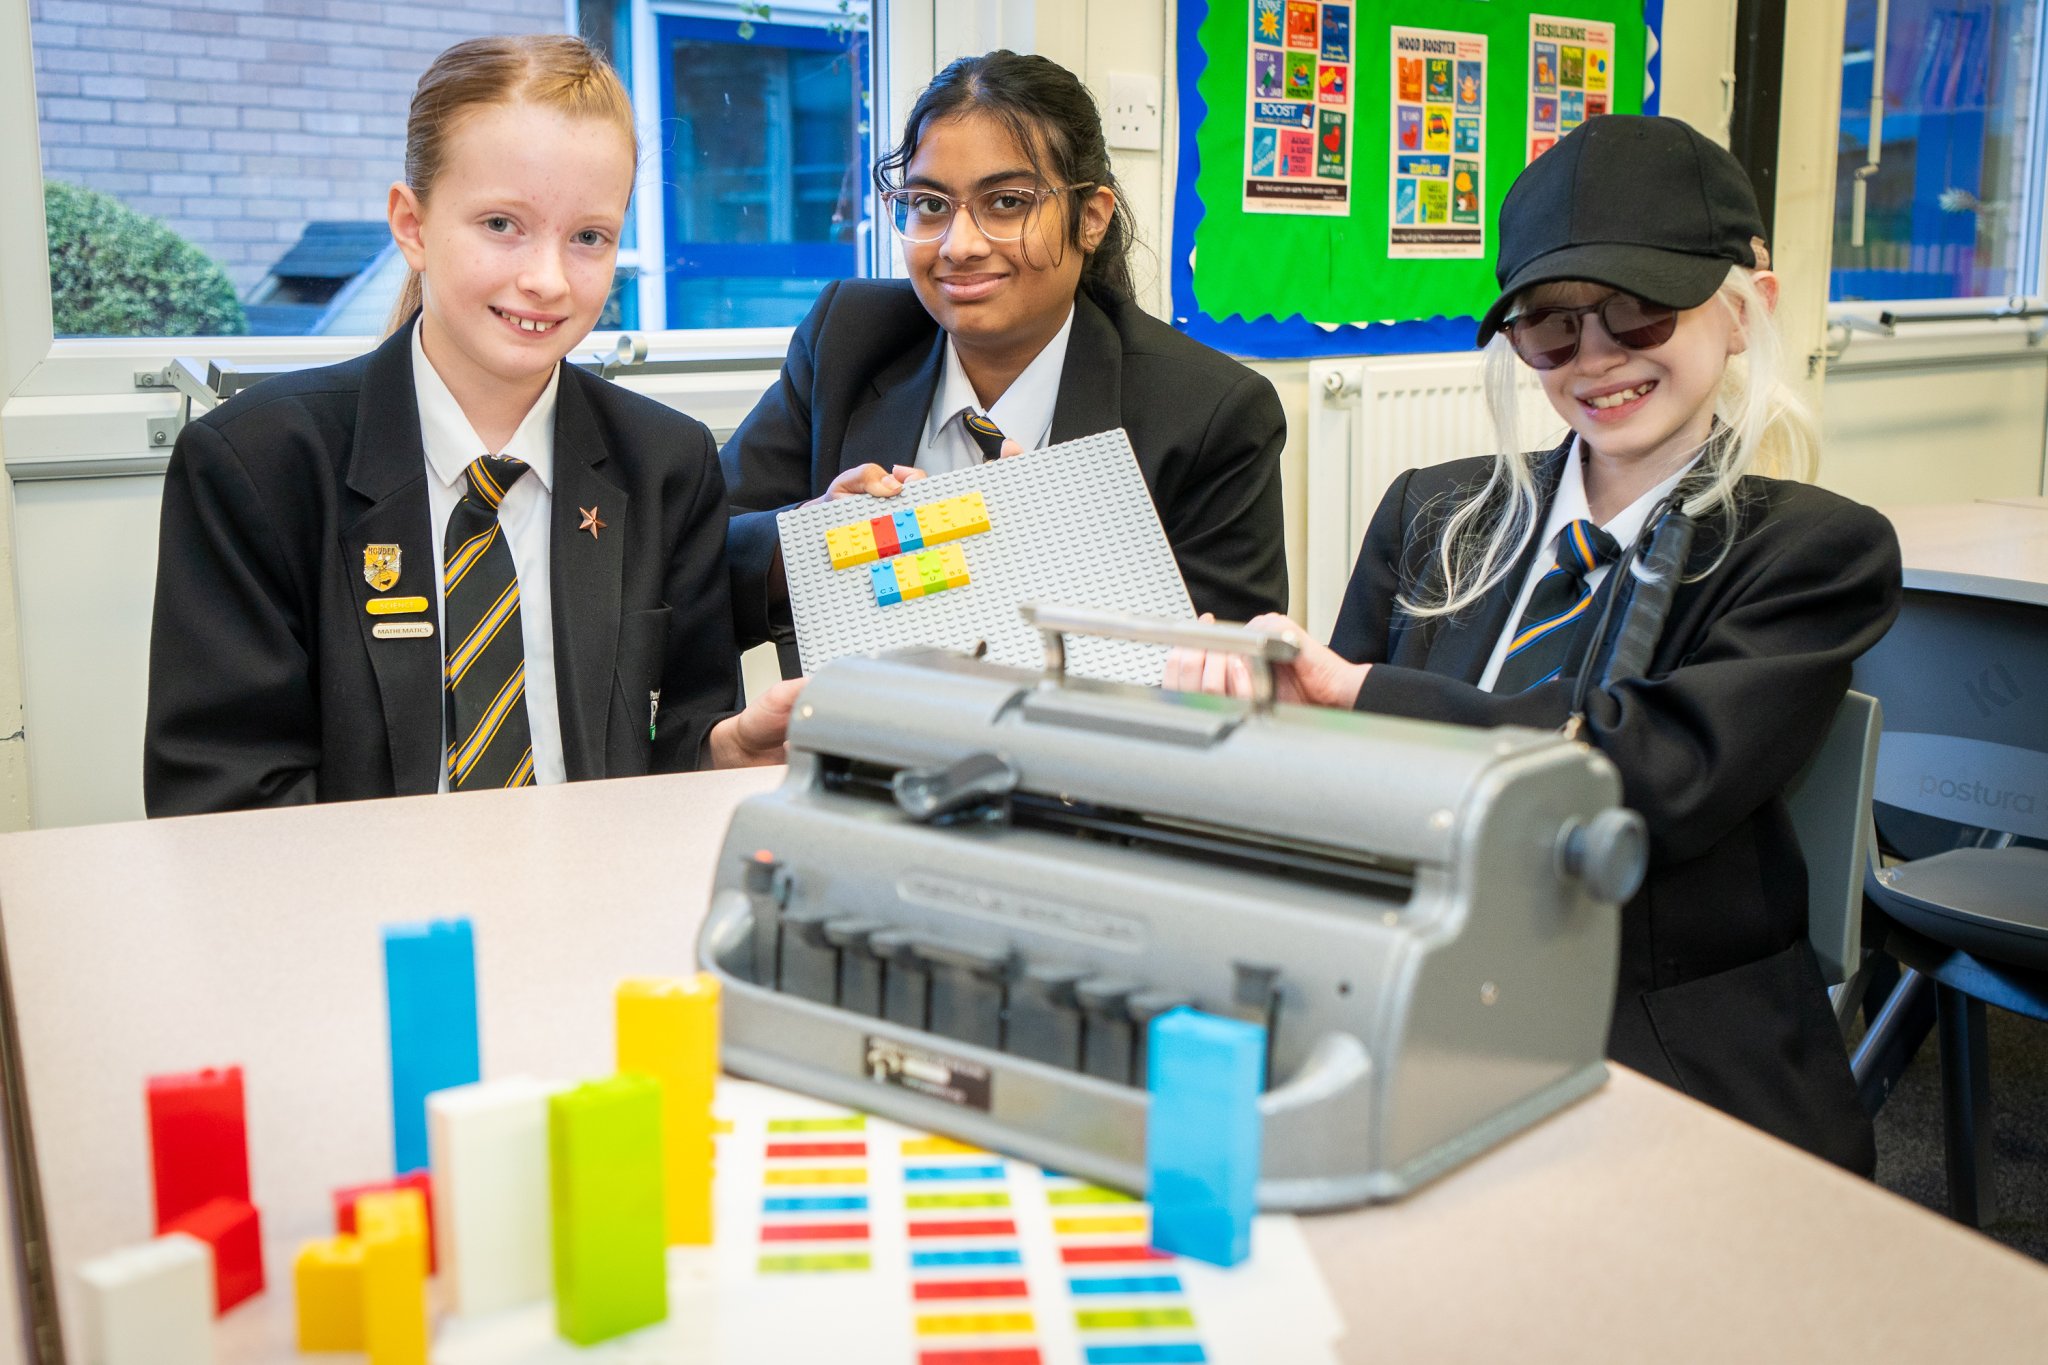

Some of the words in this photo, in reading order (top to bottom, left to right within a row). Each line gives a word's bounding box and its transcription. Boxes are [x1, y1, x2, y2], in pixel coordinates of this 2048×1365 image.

[1535, 22, 1586, 41] RESILIENCE
[1397, 36, 1420, 51] MOOD
[1422, 38, 1456, 54] BOOSTER
[1255, 52, 1268, 62] GET
[1260, 103, 1297, 117] BOOST
[1918, 775, 2034, 815] postura
